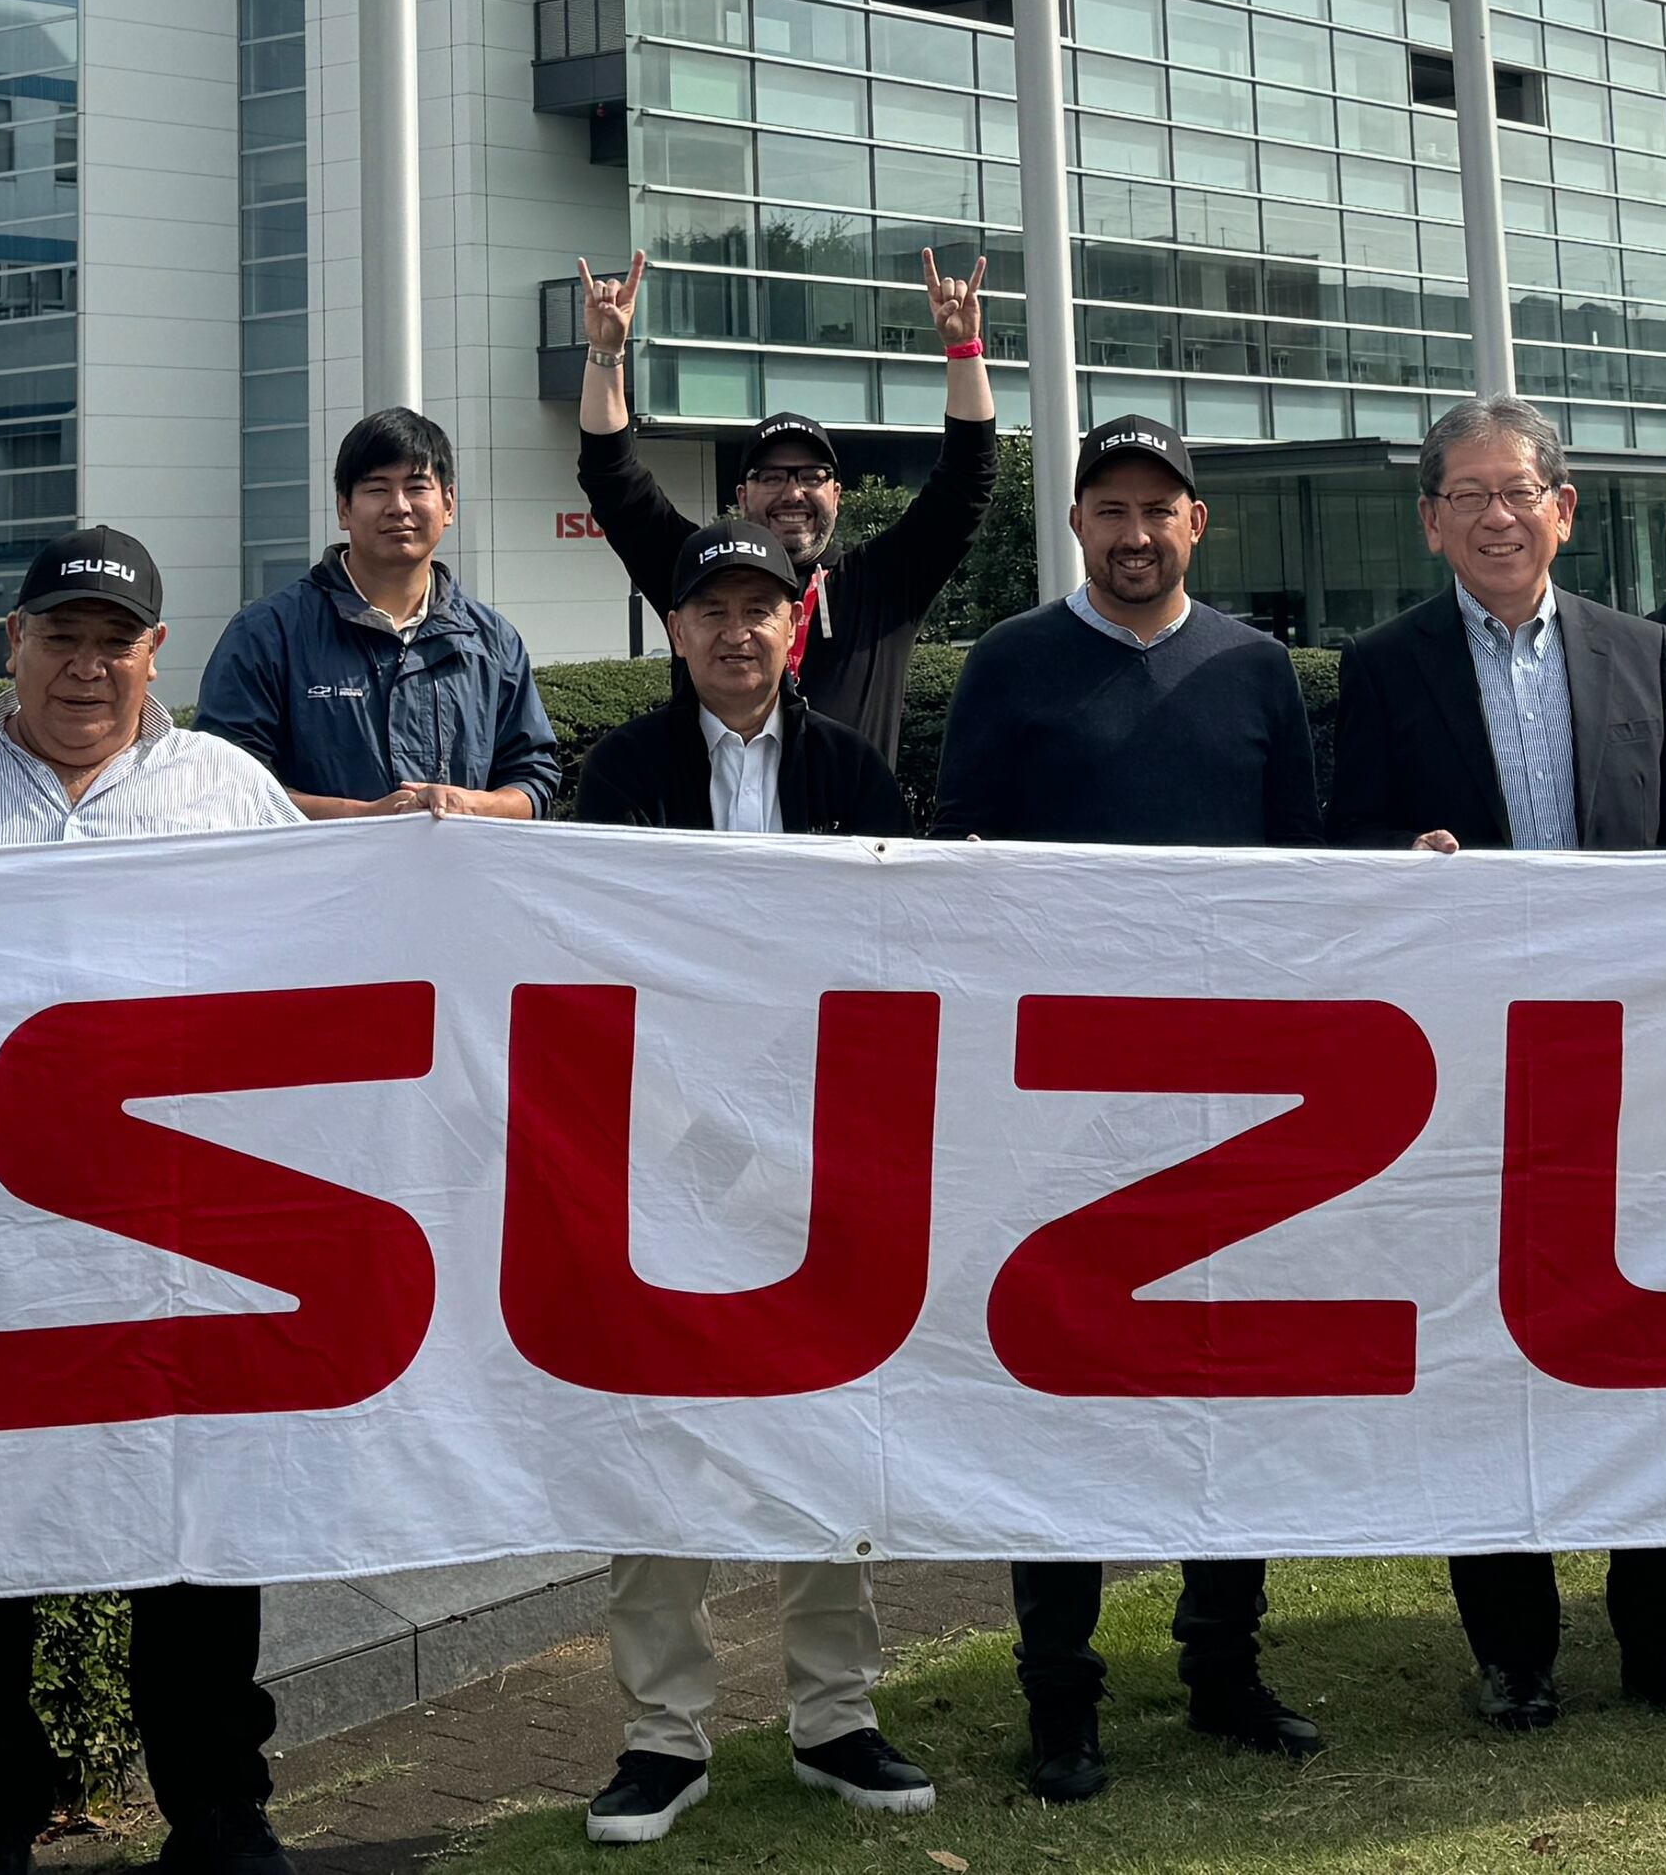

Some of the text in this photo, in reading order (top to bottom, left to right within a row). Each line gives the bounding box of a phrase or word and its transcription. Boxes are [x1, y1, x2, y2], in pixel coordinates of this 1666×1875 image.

[1100, 431, 1167, 451] ISUZU
[699, 541, 766, 564] ISUZU
[60, 559, 135, 583] ISUZU
